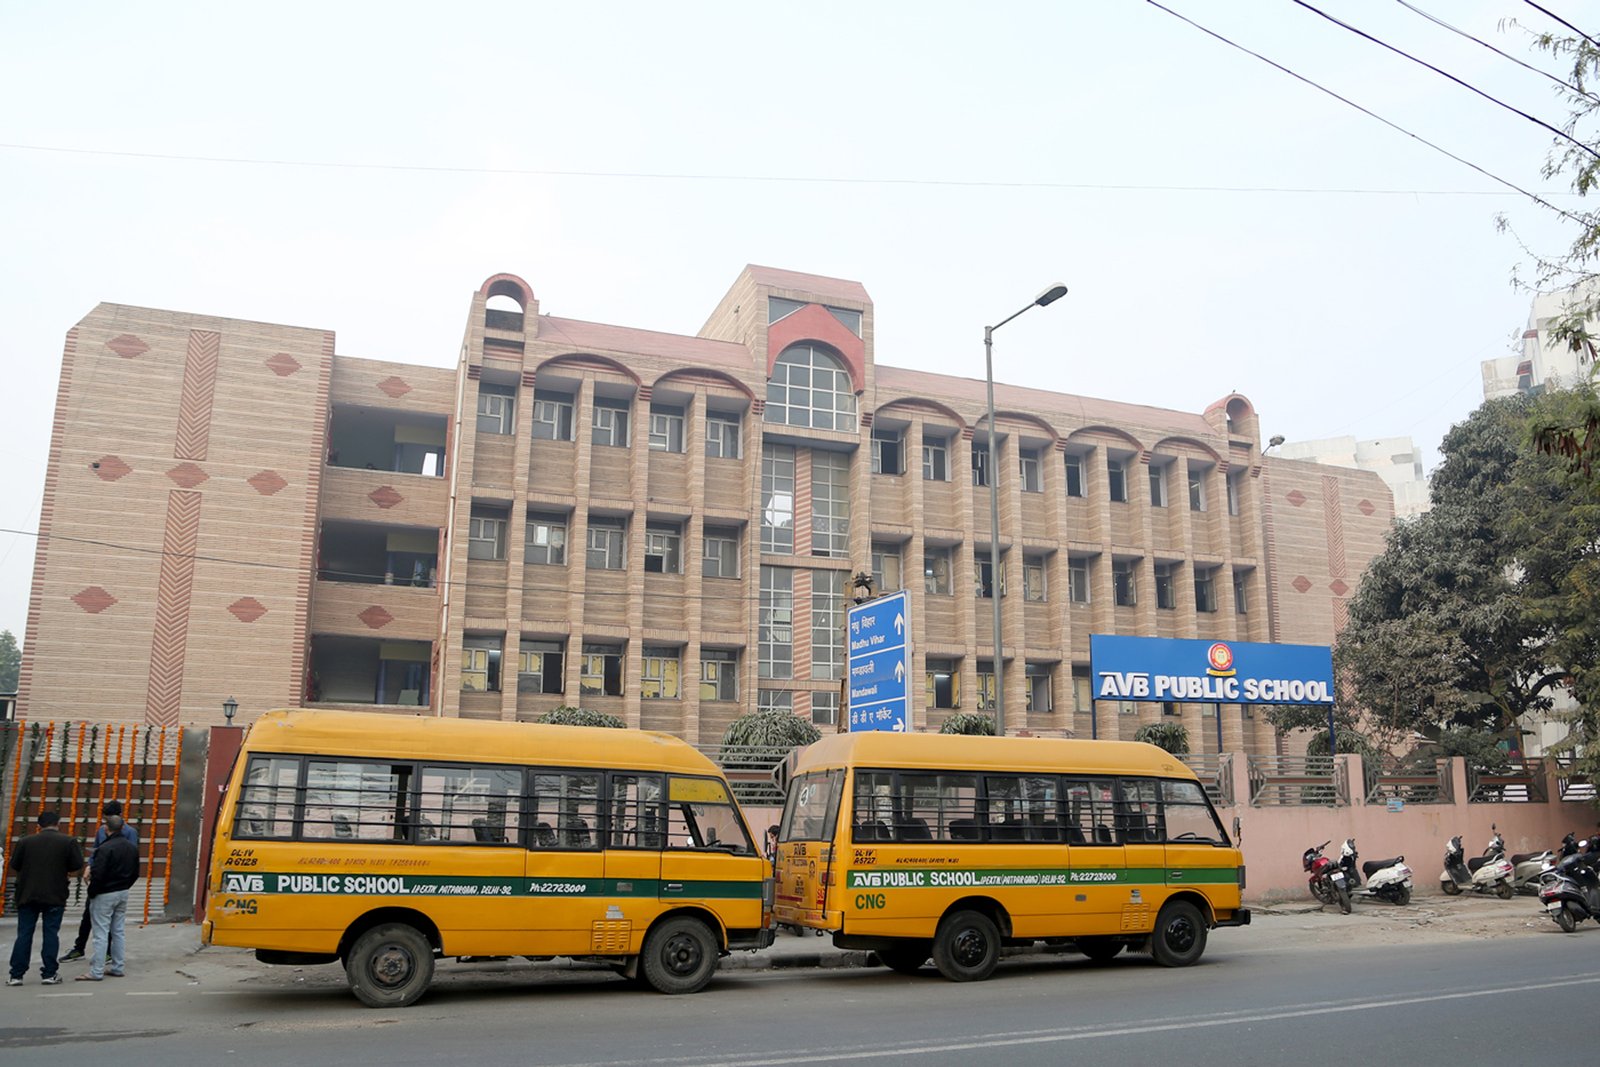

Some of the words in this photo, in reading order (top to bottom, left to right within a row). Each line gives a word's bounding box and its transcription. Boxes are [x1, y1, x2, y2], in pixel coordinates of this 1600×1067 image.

[851, 639, 870, 650] Madhu
[869, 634, 886, 645] Vihar
[852, 685, 877, 698] Mandawali
[1099, 671, 1150, 698] AVB
[1154, 675, 1240, 699] PUBLIC
[1243, 678, 1334, 702] SCHOOL
[793, 843, 807, 857] AVB
[226, 874, 265, 892] AVB
[277, 875, 340, 893] PUBLIC
[343, 876, 410, 894] SCHOOL
[853, 872, 882, 887] AVB
[883, 872, 925, 886] PUBLIC
[929, 871, 980, 886] SCHOOL
[224, 899, 258, 914] CNG
[855, 893, 886, 910] CNG
